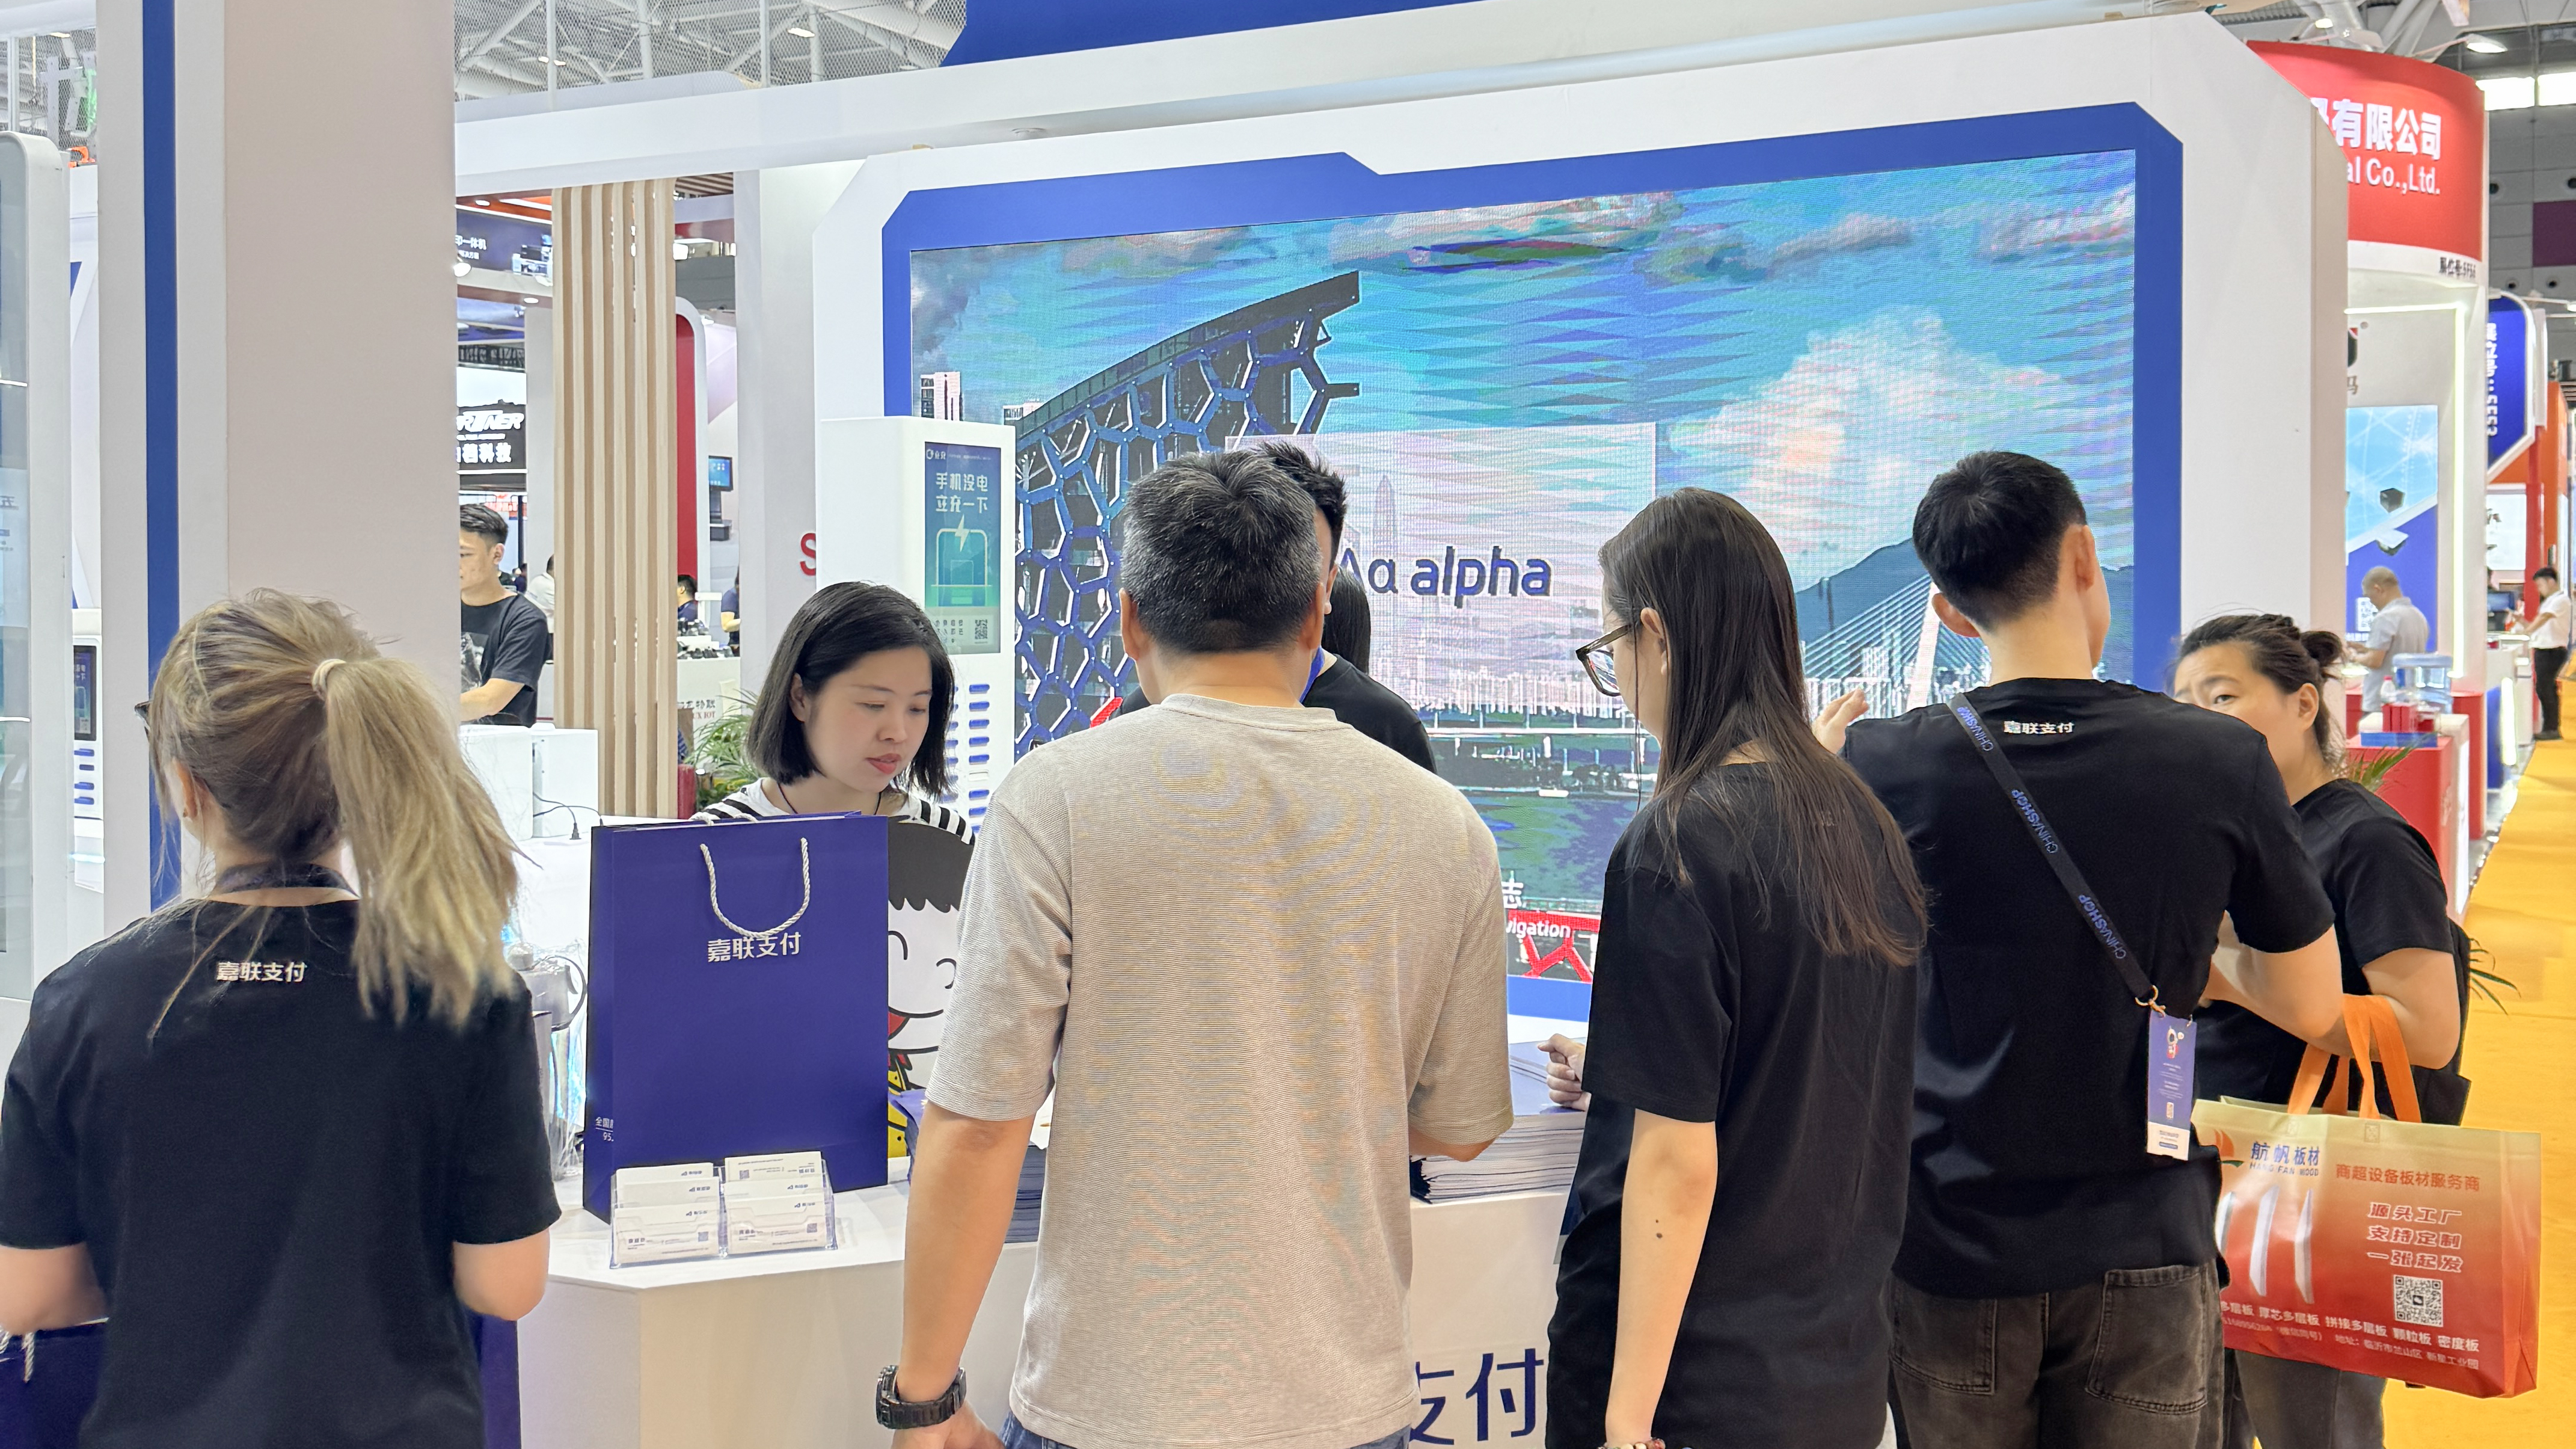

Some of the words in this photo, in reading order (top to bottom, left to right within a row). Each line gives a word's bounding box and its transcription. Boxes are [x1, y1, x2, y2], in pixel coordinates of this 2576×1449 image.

[936, 472, 988, 492] 手机没电
[936, 495, 988, 514] 立充一下
[1411, 546, 1551, 609] alpha
[1957, 706, 1993, 751] CHINASHOP
[2004, 721, 2076, 735] 嘉联支付
[2011, 789, 2058, 854] CHINASHOP
[2079, 894, 2126, 959] CHINASHOP
[707, 932, 801, 962] 嘉联支付
[216, 961, 307, 982] 嘉联支付
[2277, 1165, 2295, 1175] FAN
[2335, 1164, 2480, 1192] 商超设备板材服务商
[2367, 1202, 2462, 1225] 源头工厂
[2366, 1225, 2462, 1250] 支持定制
[2366, 1249, 2464, 1273] 一张起发
